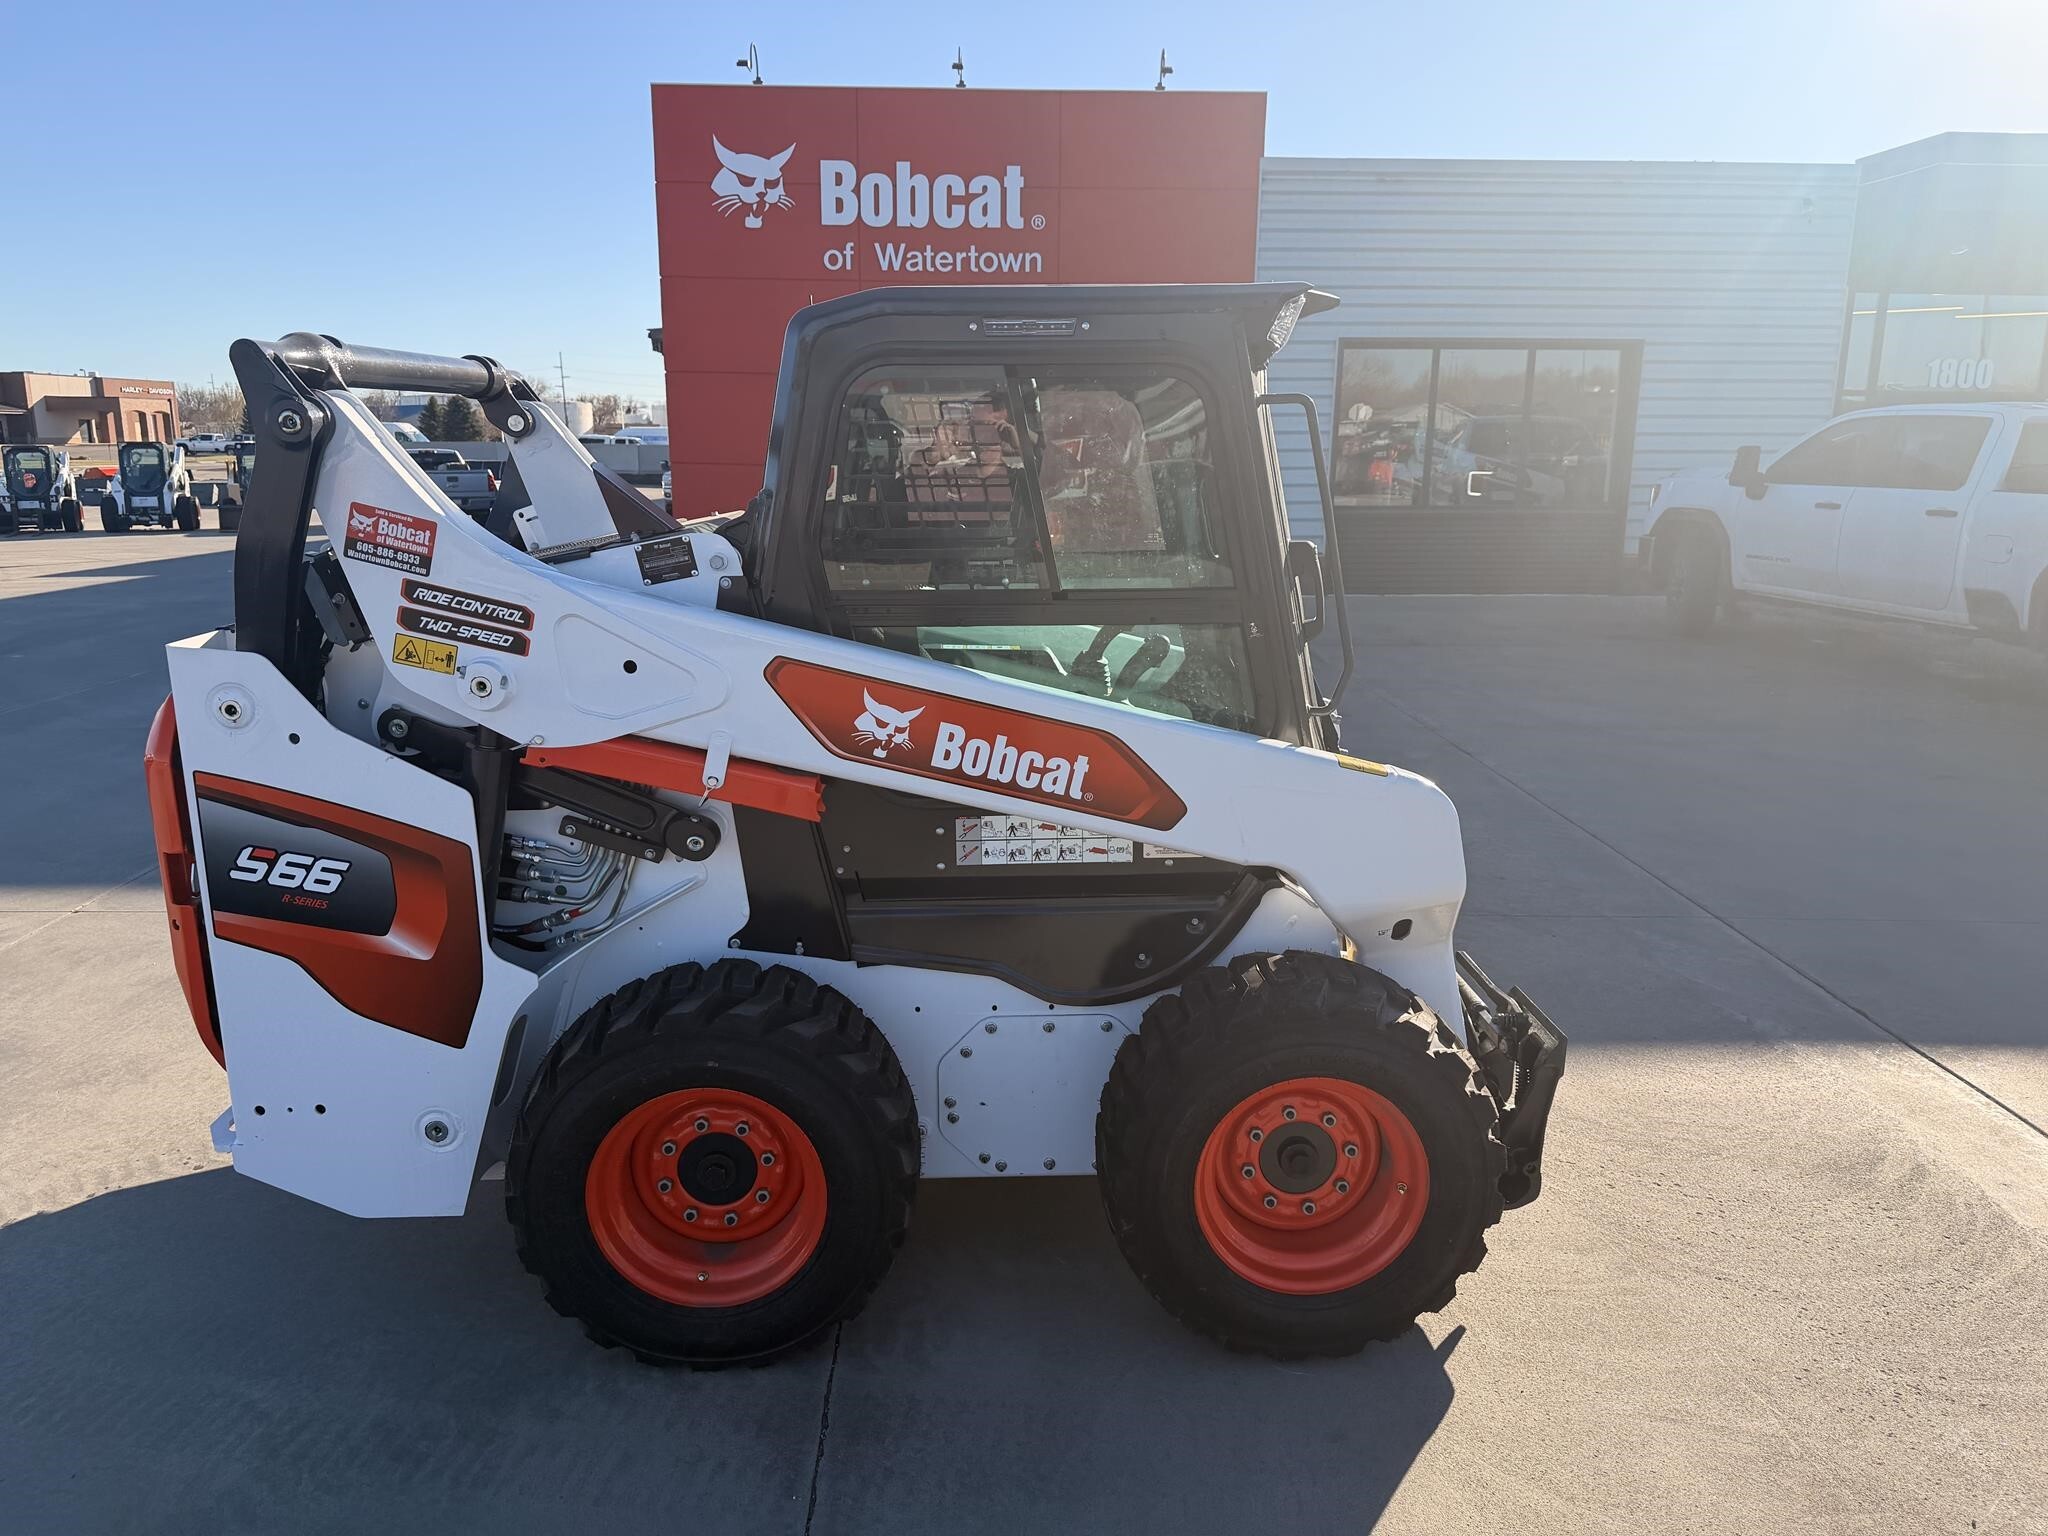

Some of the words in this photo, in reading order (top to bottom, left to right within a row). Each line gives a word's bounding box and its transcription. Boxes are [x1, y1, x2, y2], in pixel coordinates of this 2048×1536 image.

[820, 160, 1024, 229] Bobcat
[823, 242, 854, 270] of
[874, 243, 1042, 272] Watertown
[1927, 359, 1994, 389] 1800
[376, 535, 385, 544] of
[385, 536, 429, 554] Watertown
[378, 517, 431, 545] Bobcat
[347, 548, 427, 575] WatertownBobcat.com
[356, 541, 420, 565] 605-886-6933
[412, 587, 454, 606] RIDE
[451, 597, 525, 624] CONTROL
[418, 616, 514, 647] TWO-SPEED
[931, 721, 1089, 800] Bobcat
[229, 846, 351, 894] S66
[282, 893, 329, 910] R-SERIES
